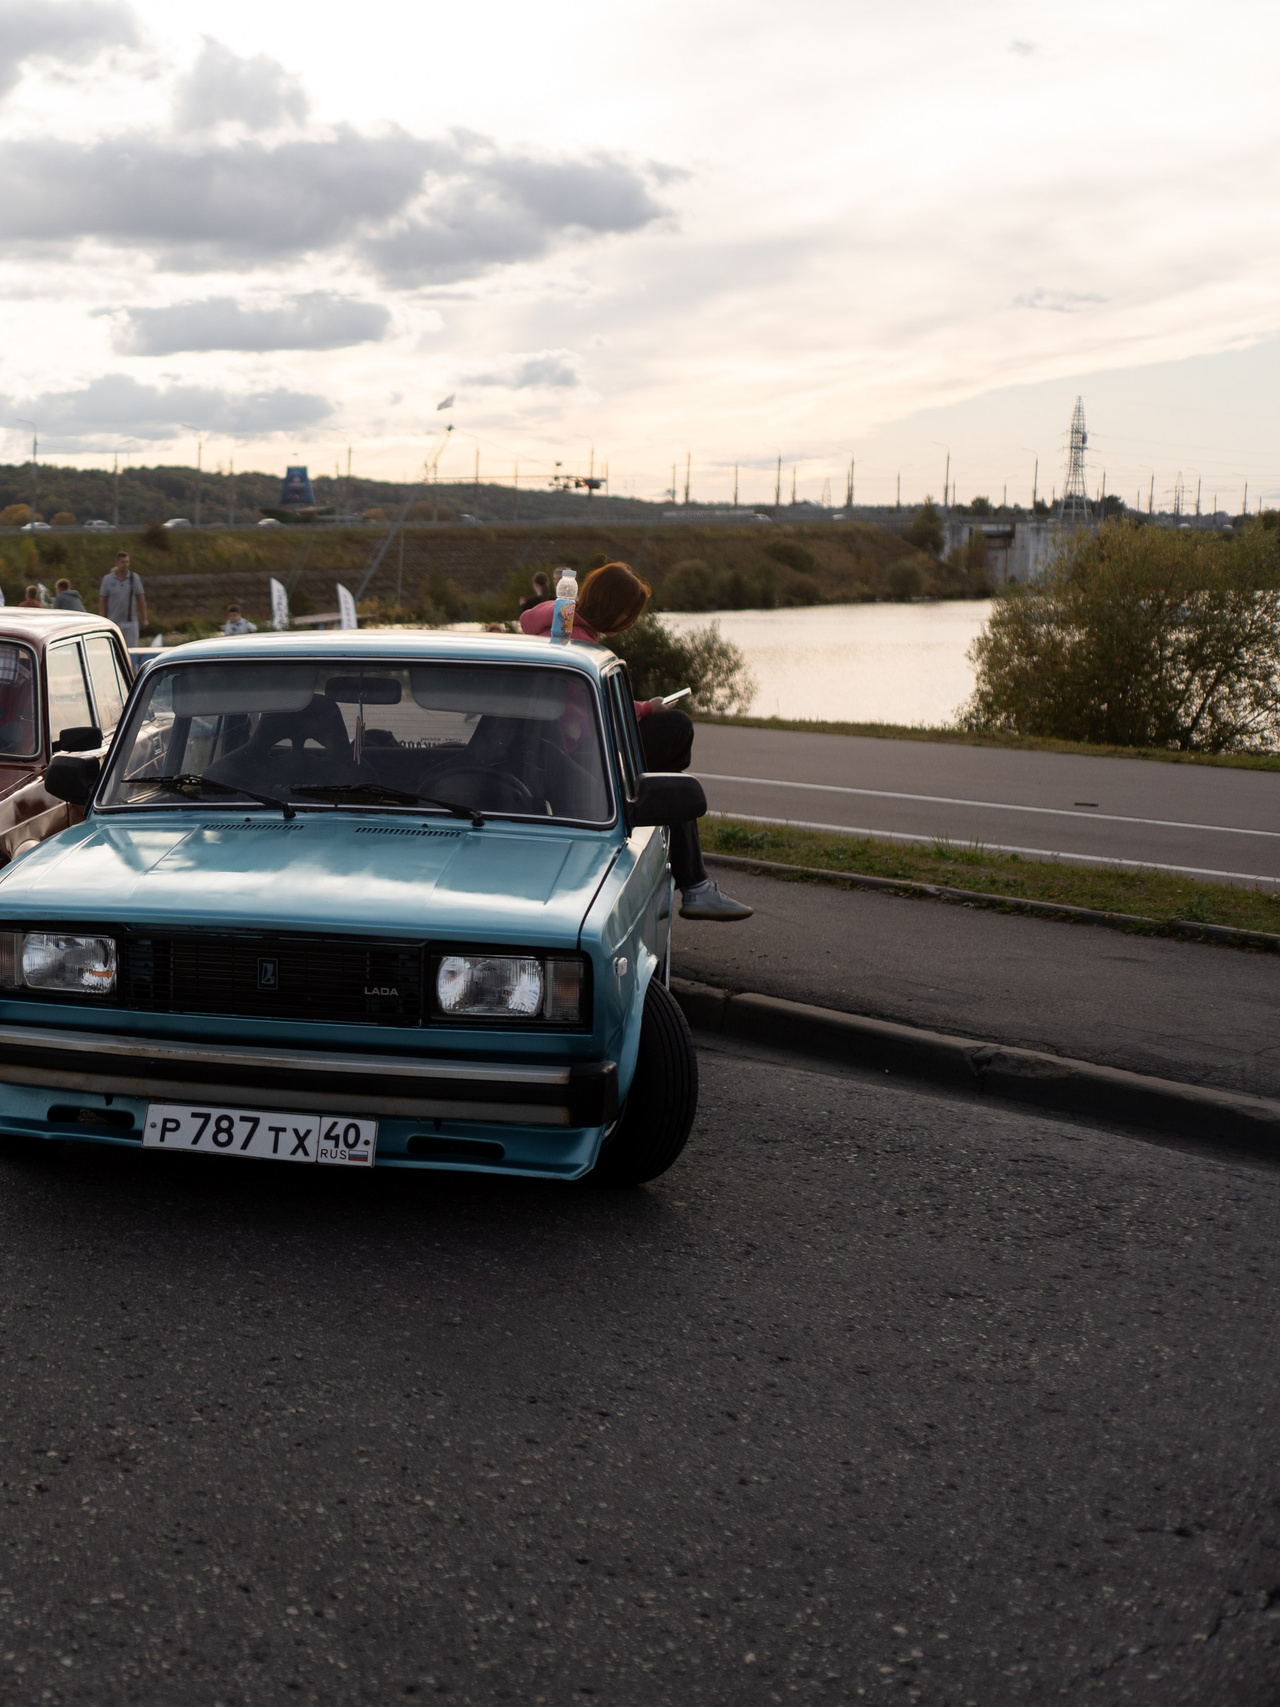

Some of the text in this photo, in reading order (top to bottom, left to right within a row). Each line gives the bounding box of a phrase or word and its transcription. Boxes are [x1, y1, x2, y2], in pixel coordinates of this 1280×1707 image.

[364, 987, 399, 996] LADA
[323, 1121, 360, 1150] 40
[320, 1149, 347, 1160] RUS
